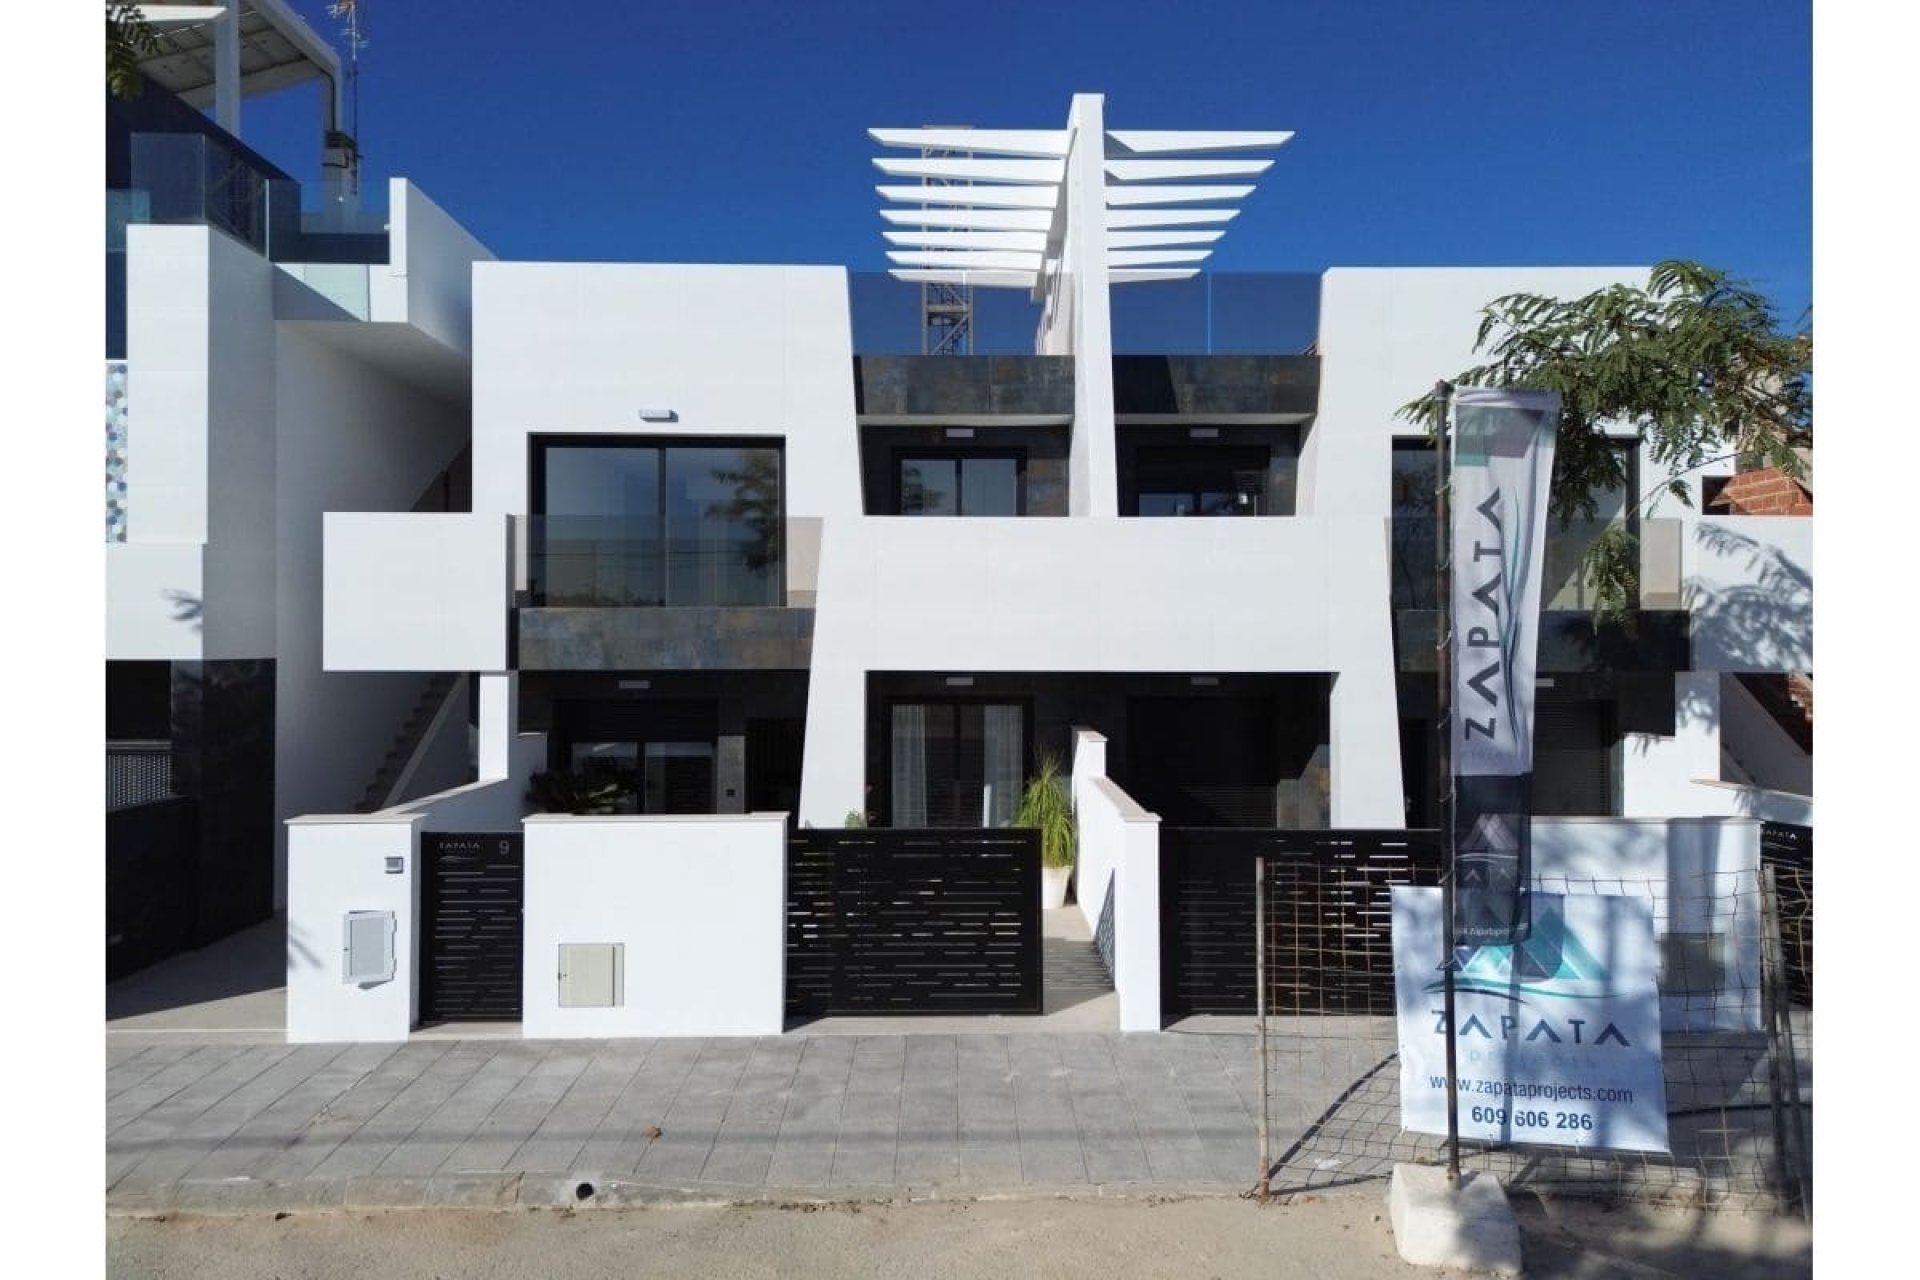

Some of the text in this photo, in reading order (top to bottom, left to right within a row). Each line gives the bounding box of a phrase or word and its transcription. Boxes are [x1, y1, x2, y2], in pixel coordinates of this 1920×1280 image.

[1464, 486, 1502, 741] ZAPATA
[498, 839, 510, 855] 9
[1431, 1010, 1632, 1047] ZAPATA
[1429, 1075, 1633, 1104] www.zapataprojects.com
[1471, 1105, 1593, 1131] 609 606 286
